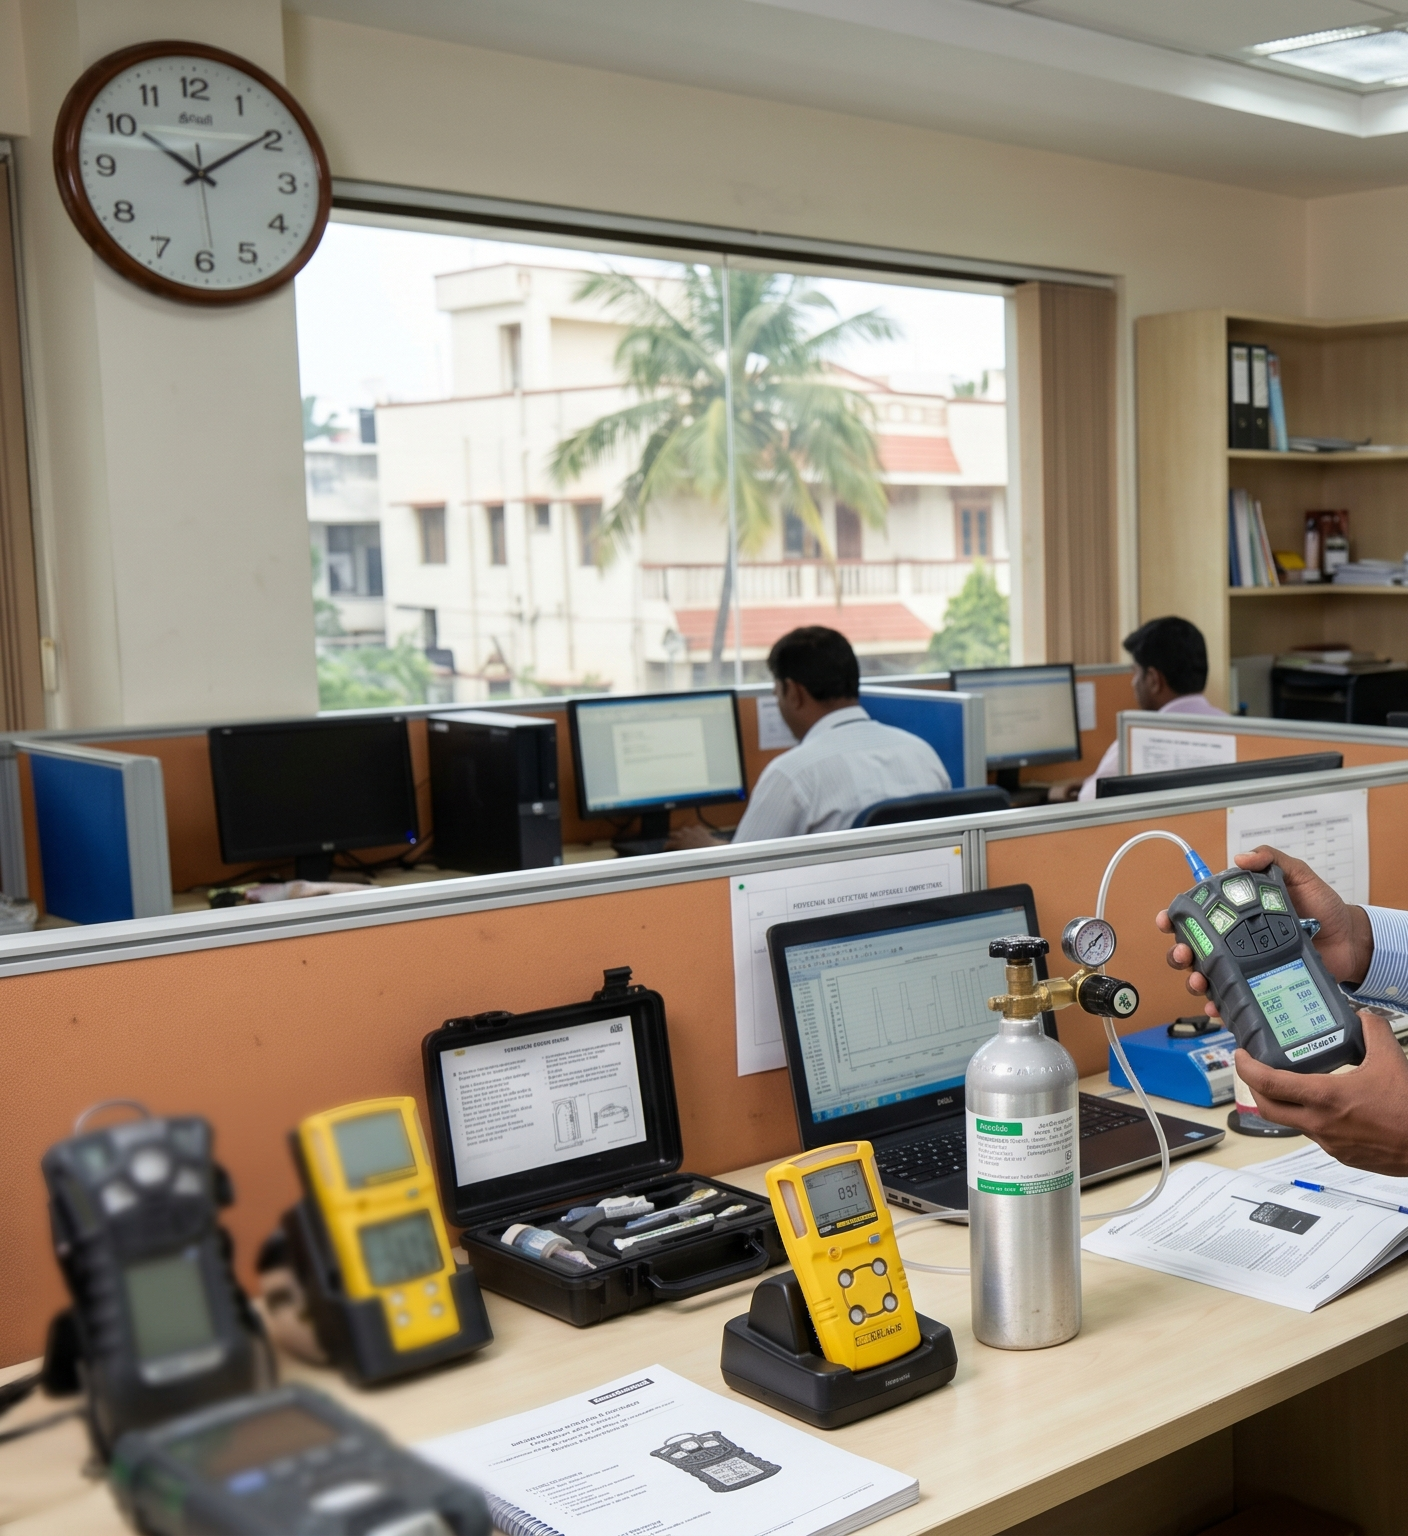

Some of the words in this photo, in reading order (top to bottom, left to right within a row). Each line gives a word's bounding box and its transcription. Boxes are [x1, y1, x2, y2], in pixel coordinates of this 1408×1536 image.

[138, 83, 159, 107] 11
[180, 76, 210, 101] 12
[235, 94, 243, 116] 1
[106, 112, 137, 137] 10
[264, 129, 283, 151] 2
[95, 153, 117, 177] 9
[277, 172, 297, 195] 3
[114, 200, 135, 223] 8
[268, 213, 289, 234] 4
[150, 235, 171, 258] 7
[237, 242, 258, 266] 5
[195, 250, 215, 273] 6
